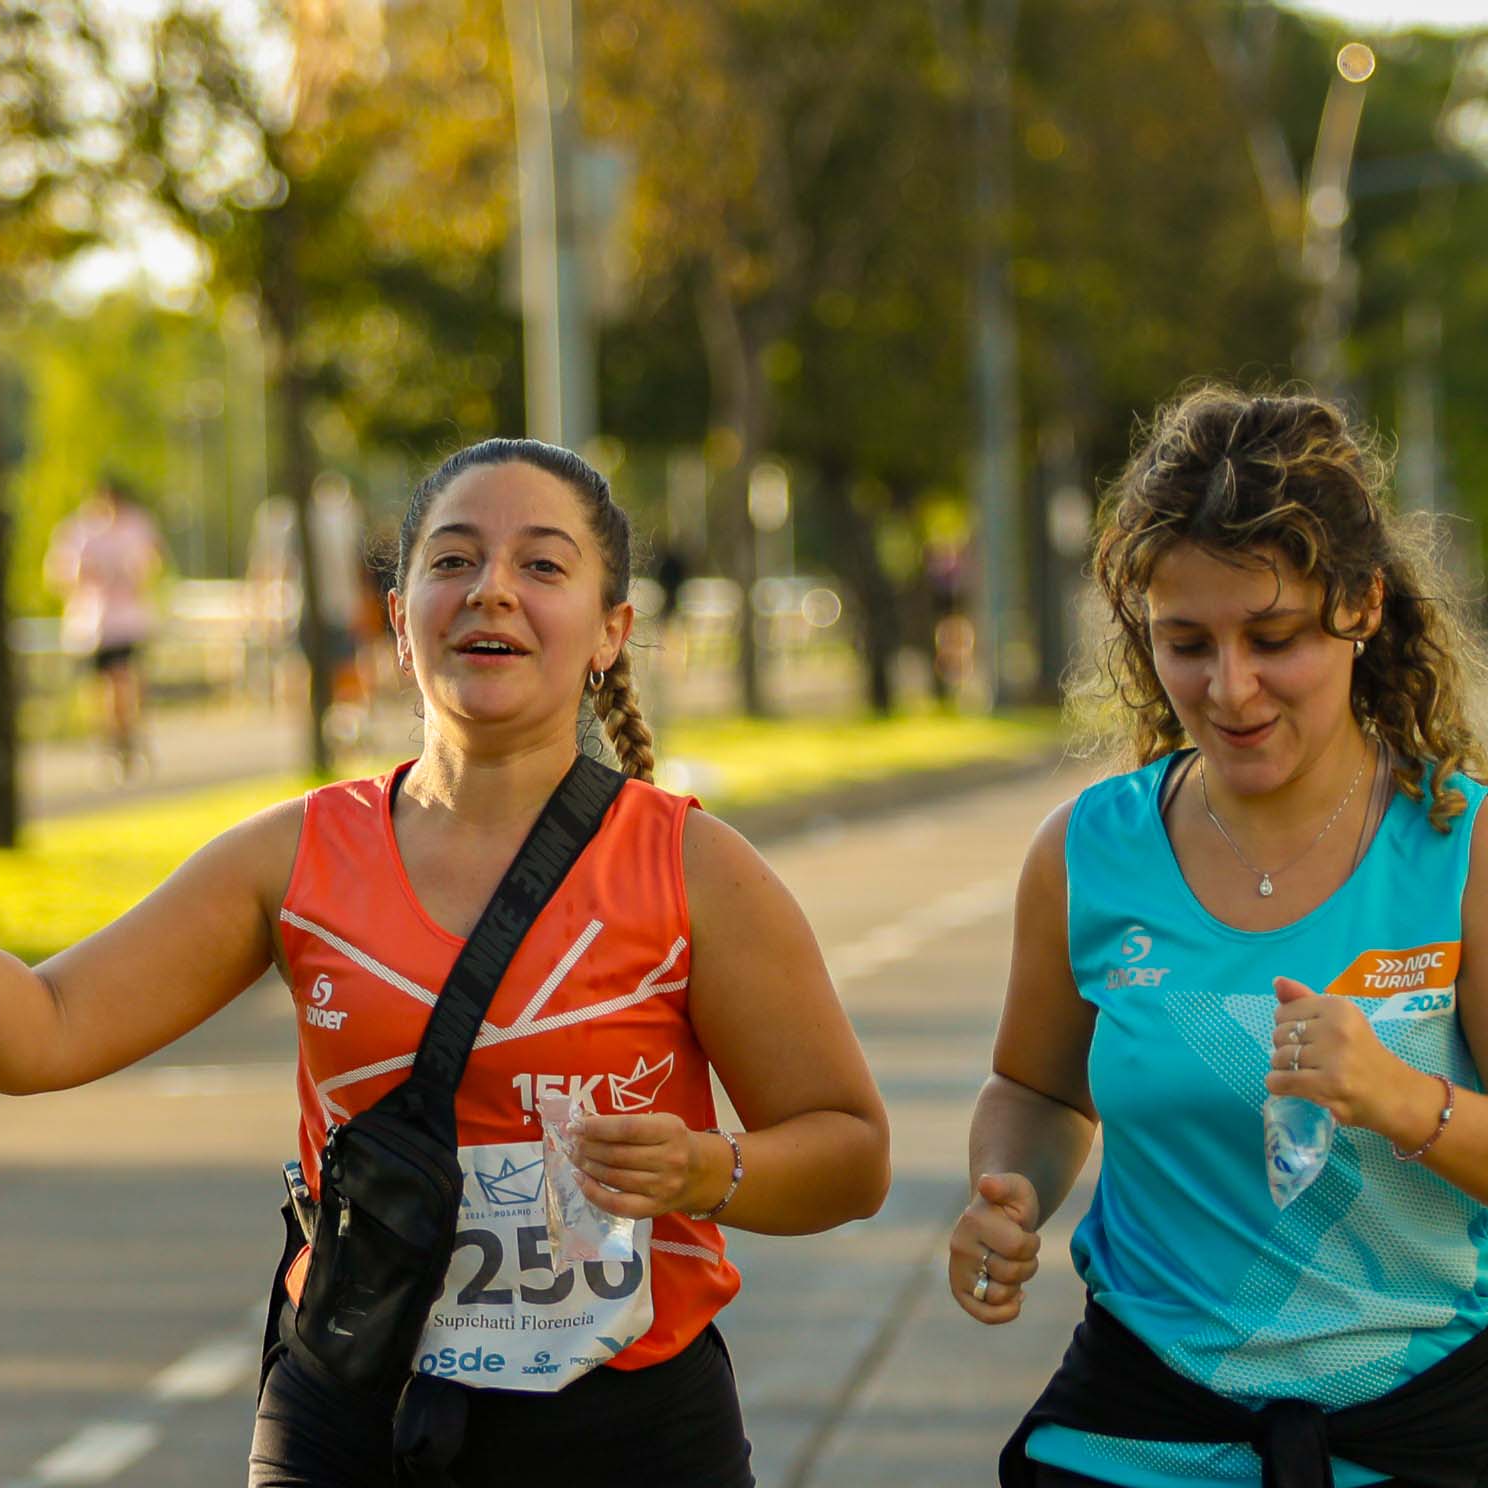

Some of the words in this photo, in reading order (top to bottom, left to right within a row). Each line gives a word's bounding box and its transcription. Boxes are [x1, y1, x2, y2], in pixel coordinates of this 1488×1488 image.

[1405, 951, 1446, 972] NOC
[1363, 971, 1425, 989] TURNA
[434, 1313, 515, 1330] Supichatti
[521, 1312, 595, 1330] Florencia
[419, 1347, 505, 1376] osde
